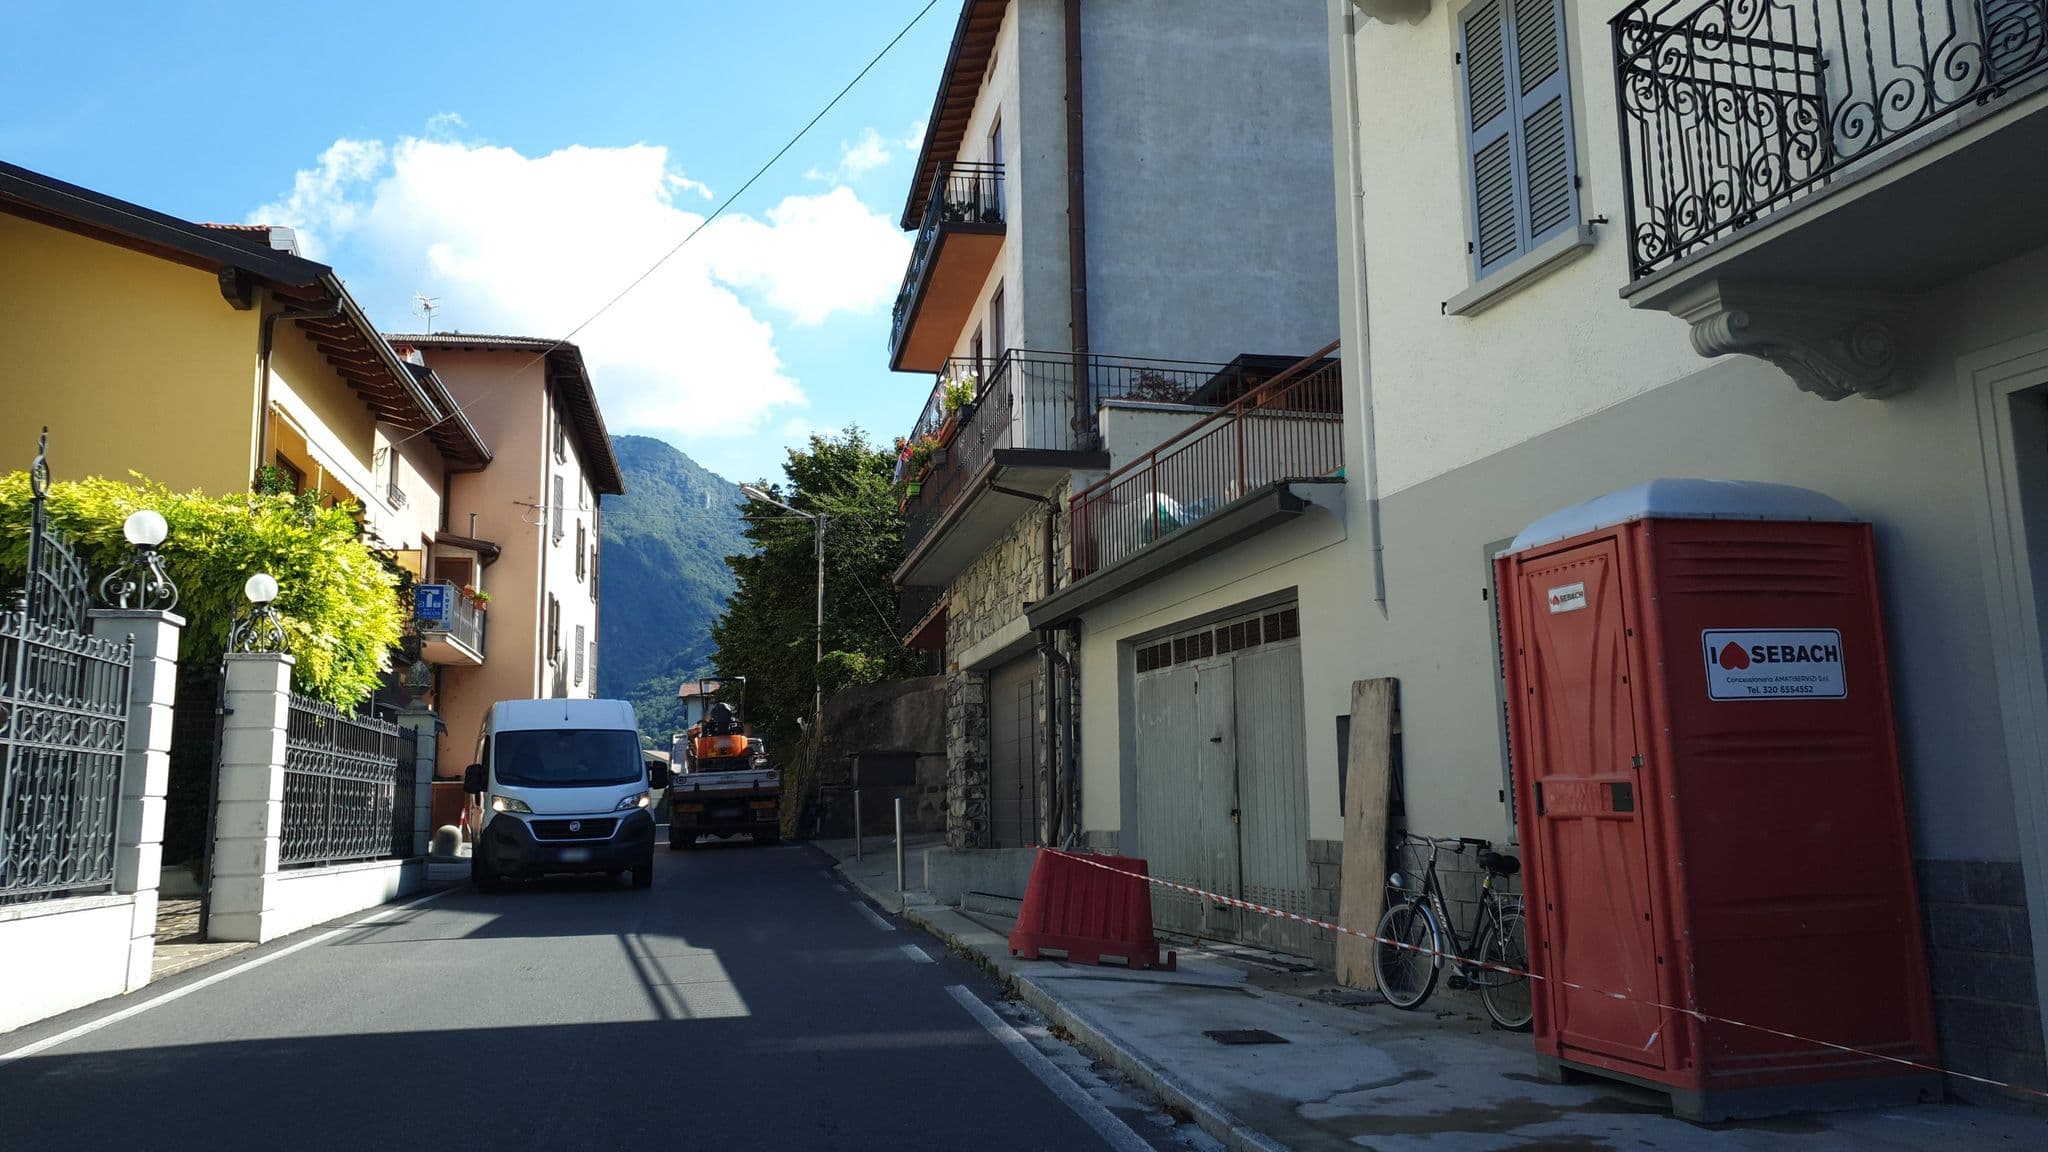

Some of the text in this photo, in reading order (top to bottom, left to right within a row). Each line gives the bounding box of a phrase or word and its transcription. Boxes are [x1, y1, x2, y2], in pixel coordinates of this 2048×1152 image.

[1560, 591, 1584, 602] SEBACH
[1710, 645, 1838, 664] I SEBACH
